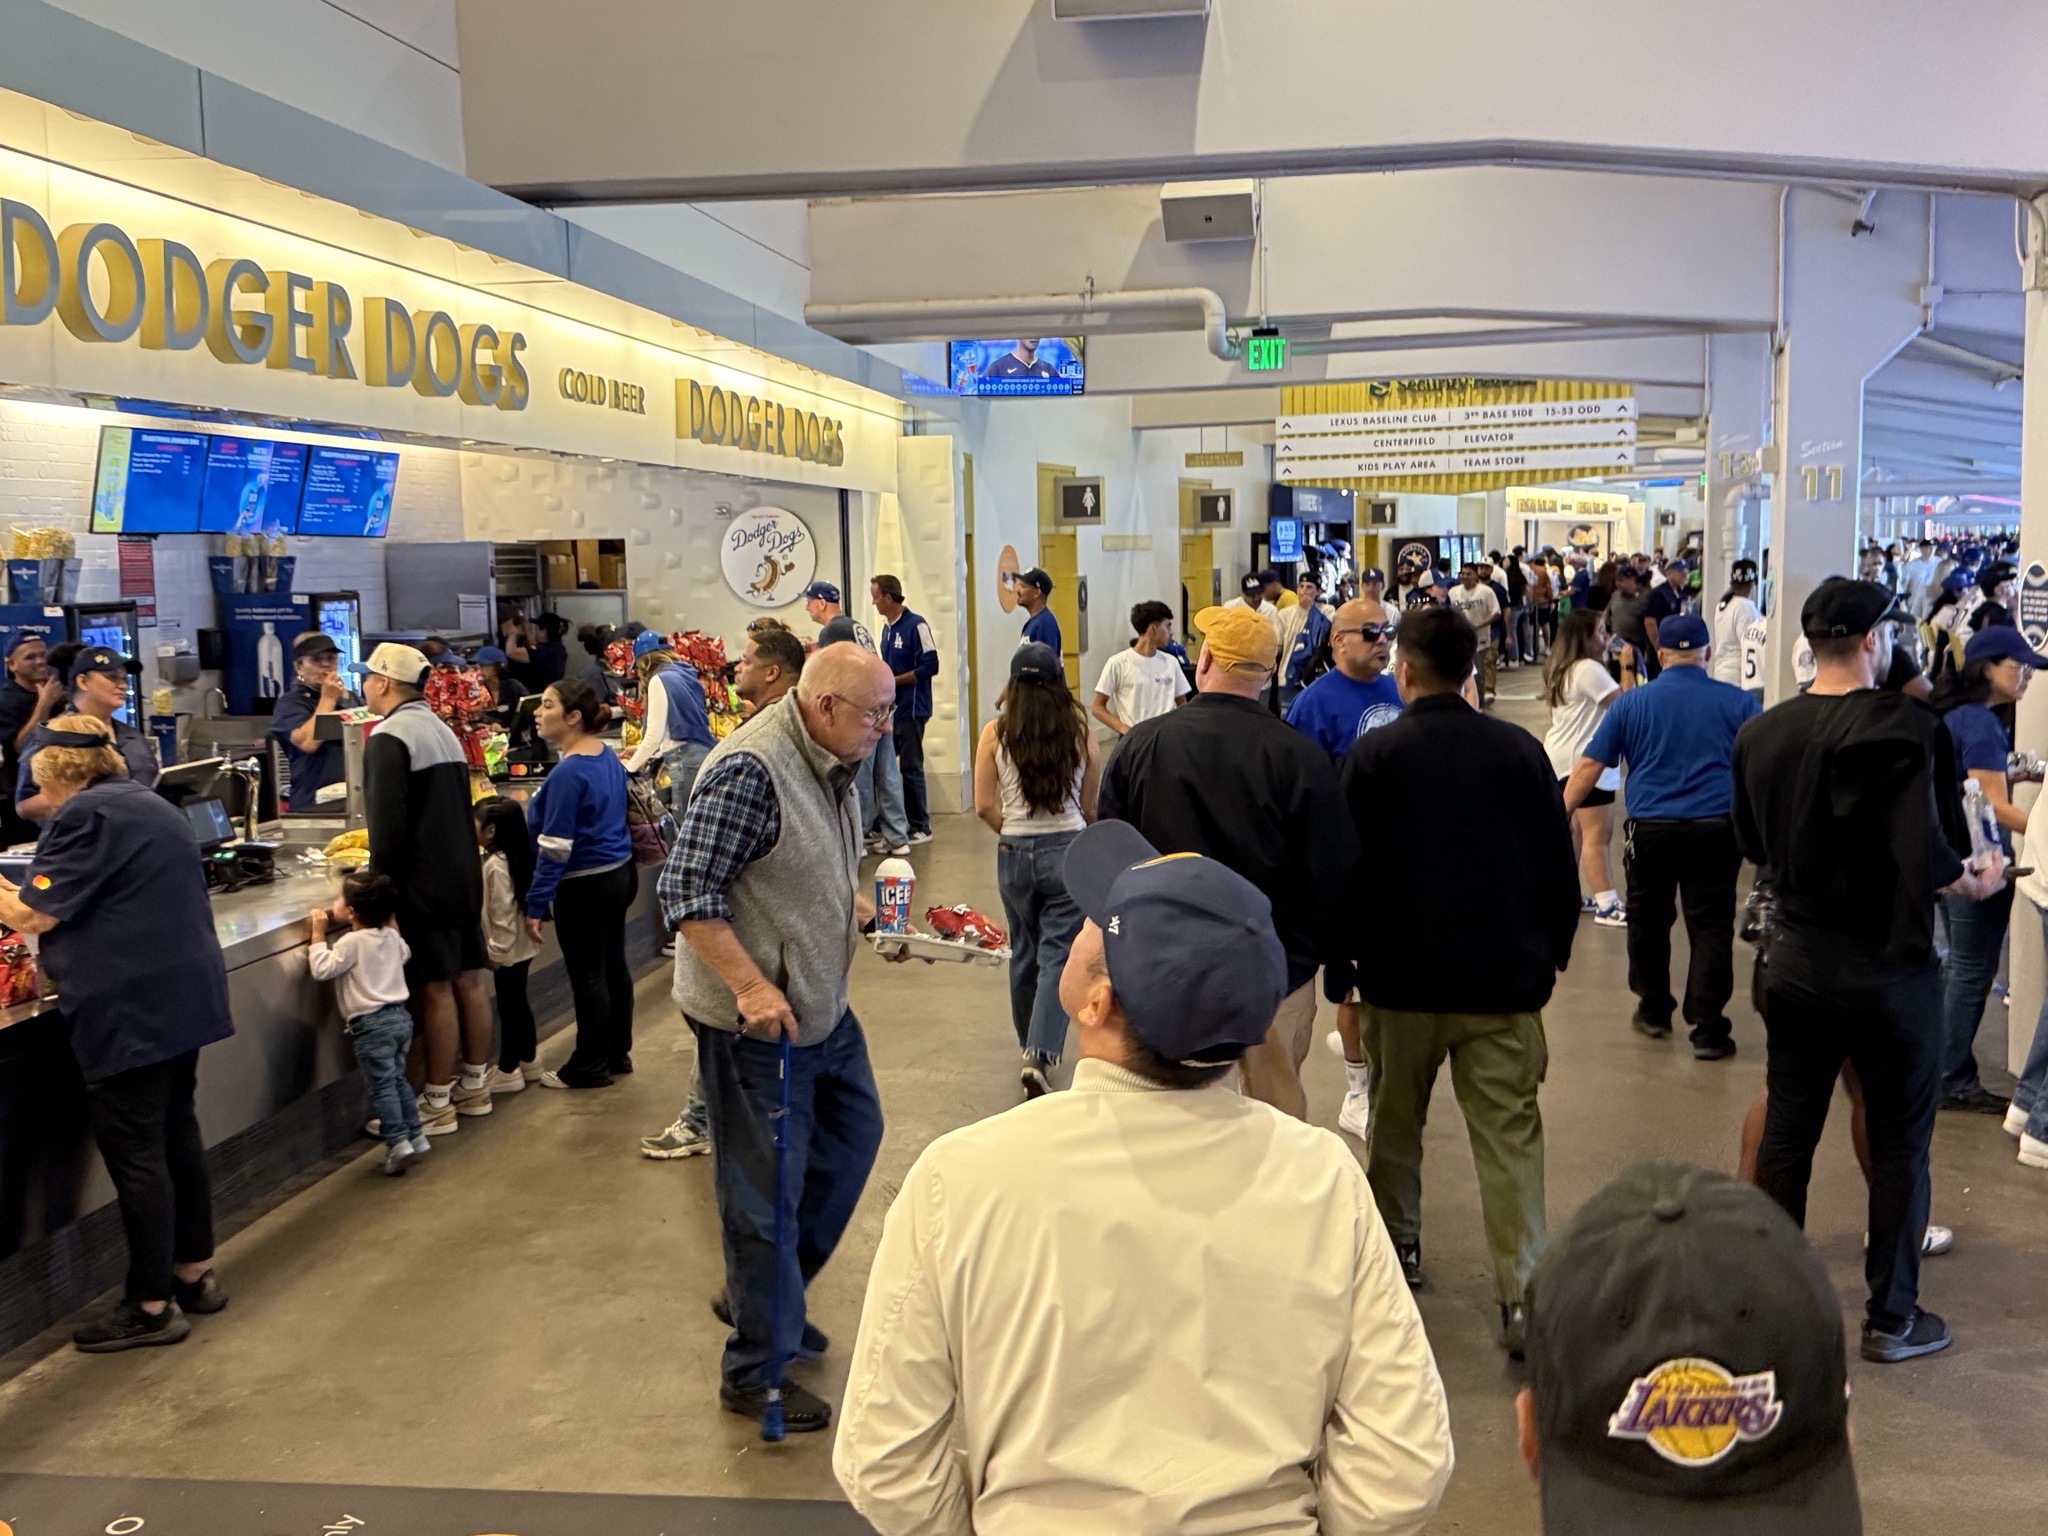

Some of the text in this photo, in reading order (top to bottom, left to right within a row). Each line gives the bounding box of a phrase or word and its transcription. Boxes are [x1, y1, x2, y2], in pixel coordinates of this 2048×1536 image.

[0, 197, 530, 411] DODGER DOGS
[1248, 338, 1286, 370] EXIT
[559, 367, 646, 415] COLD BEER
[675, 378, 844, 467] DODGER DOGS
[1330, 413, 1437, 427] LEXUS BASELINE CLUB
[1482, 409, 1508, 420] BASE
[1511, 408, 1534, 418] SIDE
[1577, 405, 1601, 415] ODD
[1373, 437, 1436, 448] CENTERFIELD
[1464, 433, 1514, 444] ELEVATOR
[1801, 440, 1844, 459] Section
[1357, 460, 1436, 472] KIDS PLAY AREA
[1463, 455, 1526, 468] TEAM STORE
[1801, 464, 1842, 500] 11
[731, 519, 778, 552] Dodger
[766, 526, 805, 553] Dogs
[1745, 648, 1756, 679] 5
[881, 884, 912, 906] ICEE
